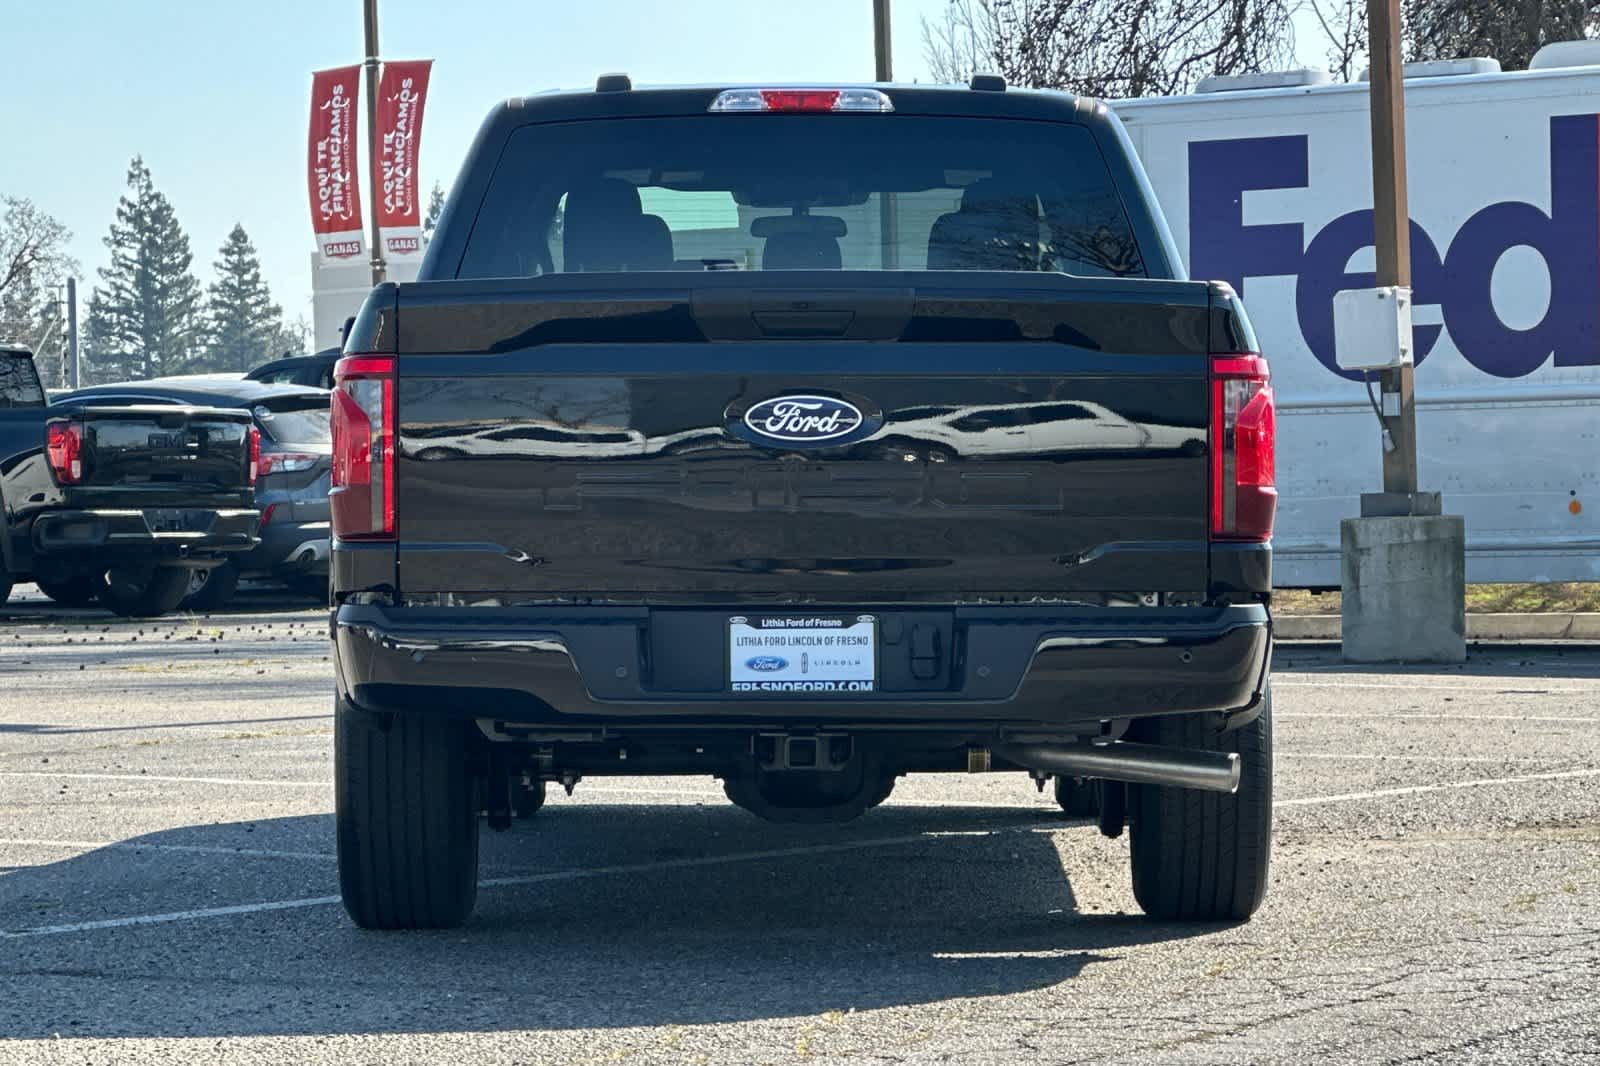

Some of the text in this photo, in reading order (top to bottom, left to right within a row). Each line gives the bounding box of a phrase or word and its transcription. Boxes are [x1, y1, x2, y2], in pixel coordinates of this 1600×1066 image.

[330, 84, 344, 213] FINANCIAMOS
[384, 131, 395, 156] TE
[395, 77, 413, 208] FINANCIAMOS
[765, 401, 841, 432] Ford
[762, 618, 842, 627] Lithia Ford of Fresno
[736, 635, 869, 647] LITHIA FORD LINCOLN OF FRESNO
